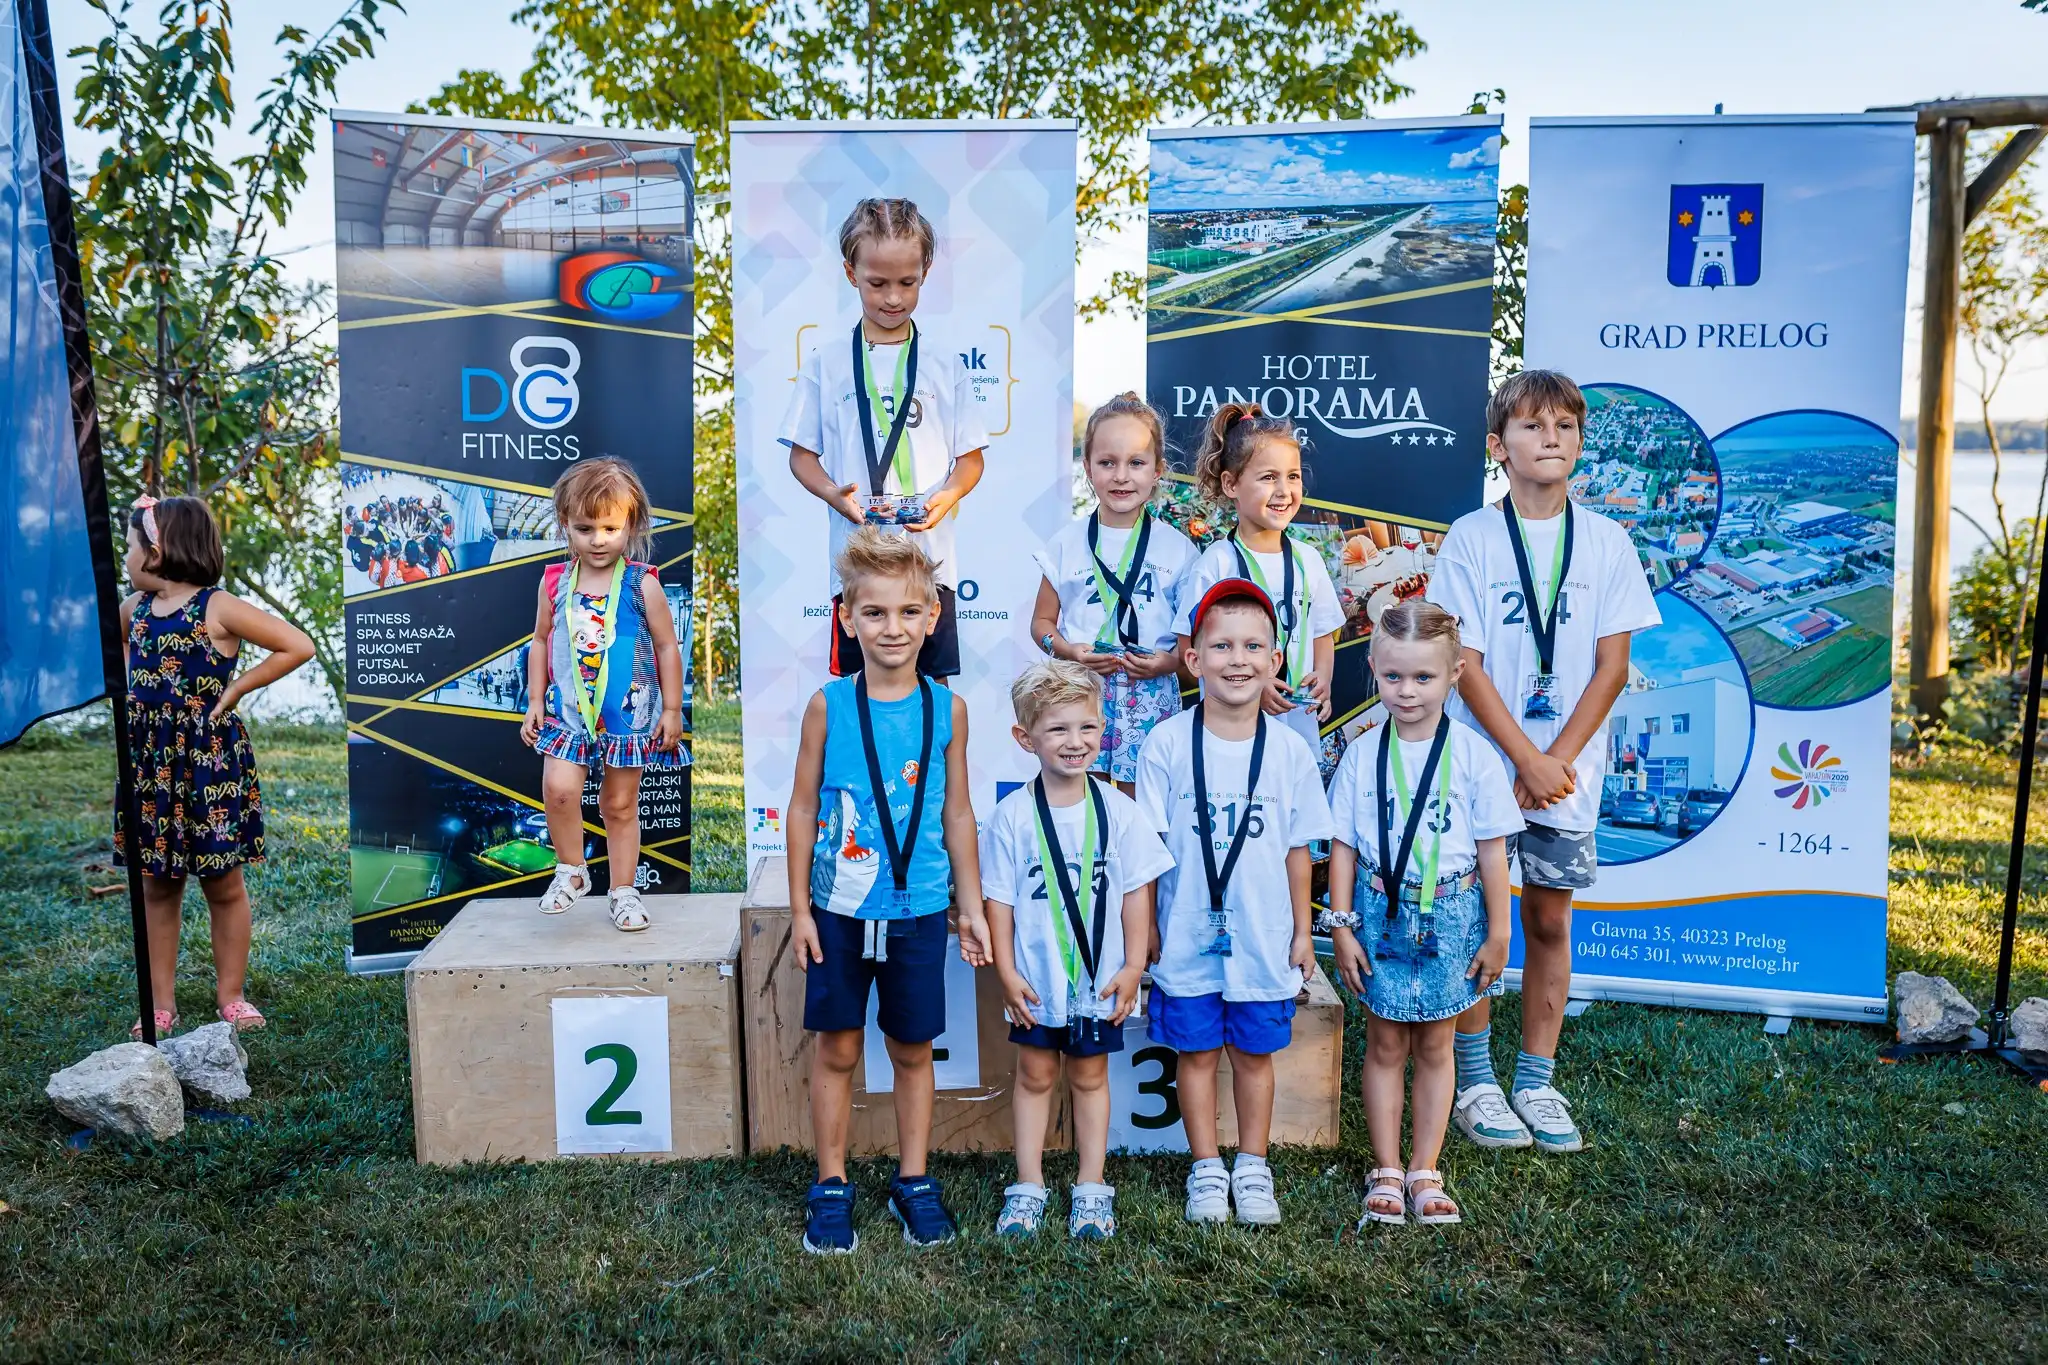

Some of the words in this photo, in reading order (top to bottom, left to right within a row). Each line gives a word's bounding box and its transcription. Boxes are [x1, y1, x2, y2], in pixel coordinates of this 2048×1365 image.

[1600, 324, 1686, 349] GRAD
[1698, 322, 1829, 348] PRELOG
[1262, 355, 1376, 381] HOTEL
[1173, 385, 1430, 421] PANORAMA
[462, 432, 580, 461] FITNESS
[356, 613, 411, 625] FITNESS
[356, 628, 383, 640] SPA
[385, 628, 396, 640] &
[399, 624, 455, 639] MASAŽA
[357, 642, 422, 655] RUKOMET
[357, 658, 409, 670] FUTSAL
[357, 672, 426, 685] ODBOJKA
[653, 803, 681, 815] MAN
[752, 843, 782, 852] Projekt
[1778, 832, 1832, 855] 1264
[389, 925, 442, 938] PANORAM
[410, 919, 437, 928] HOTEL
[1591, 921, 1648, 940] Glavna
[1652, 926, 1676, 943] 35,
[1680, 928, 1729, 946] 40323
[1735, 931, 1787, 954] Prelog
[1577, 941, 1606, 957] 040
[1611, 944, 1639, 960] 645
[1643, 947, 1677, 966] 301,
[1682, 952, 1800, 975] www.prelog.hr
[584, 1042, 643, 1126] 2
[1131, 1045, 1182, 1130] 3
